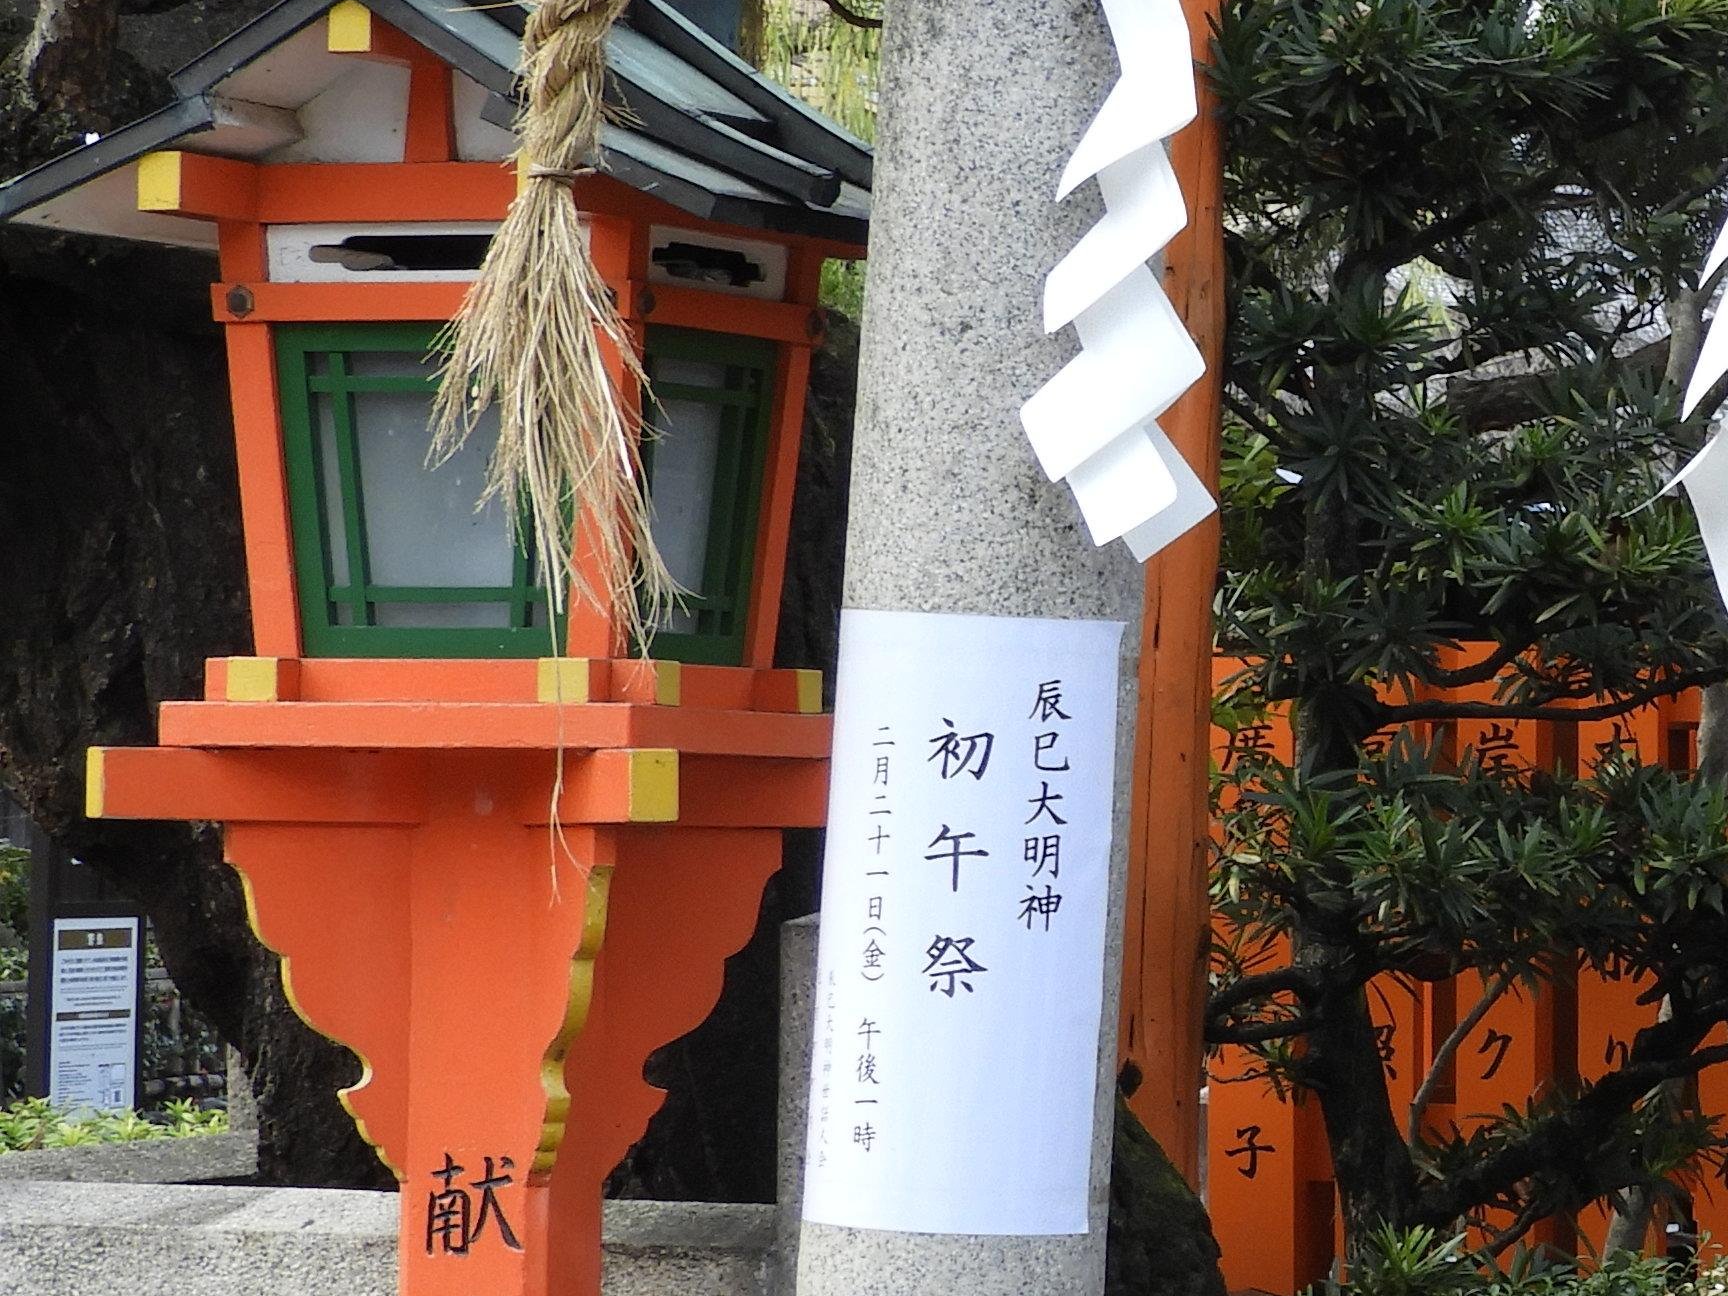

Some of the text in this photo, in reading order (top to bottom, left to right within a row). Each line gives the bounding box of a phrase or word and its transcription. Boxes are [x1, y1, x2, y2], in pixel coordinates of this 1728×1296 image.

[921, 716, 995, 1000] 初午祭
[1016, 679, 1073, 933] 辰巳大明神
[853, 1016, 882, 1153] 午後一時
